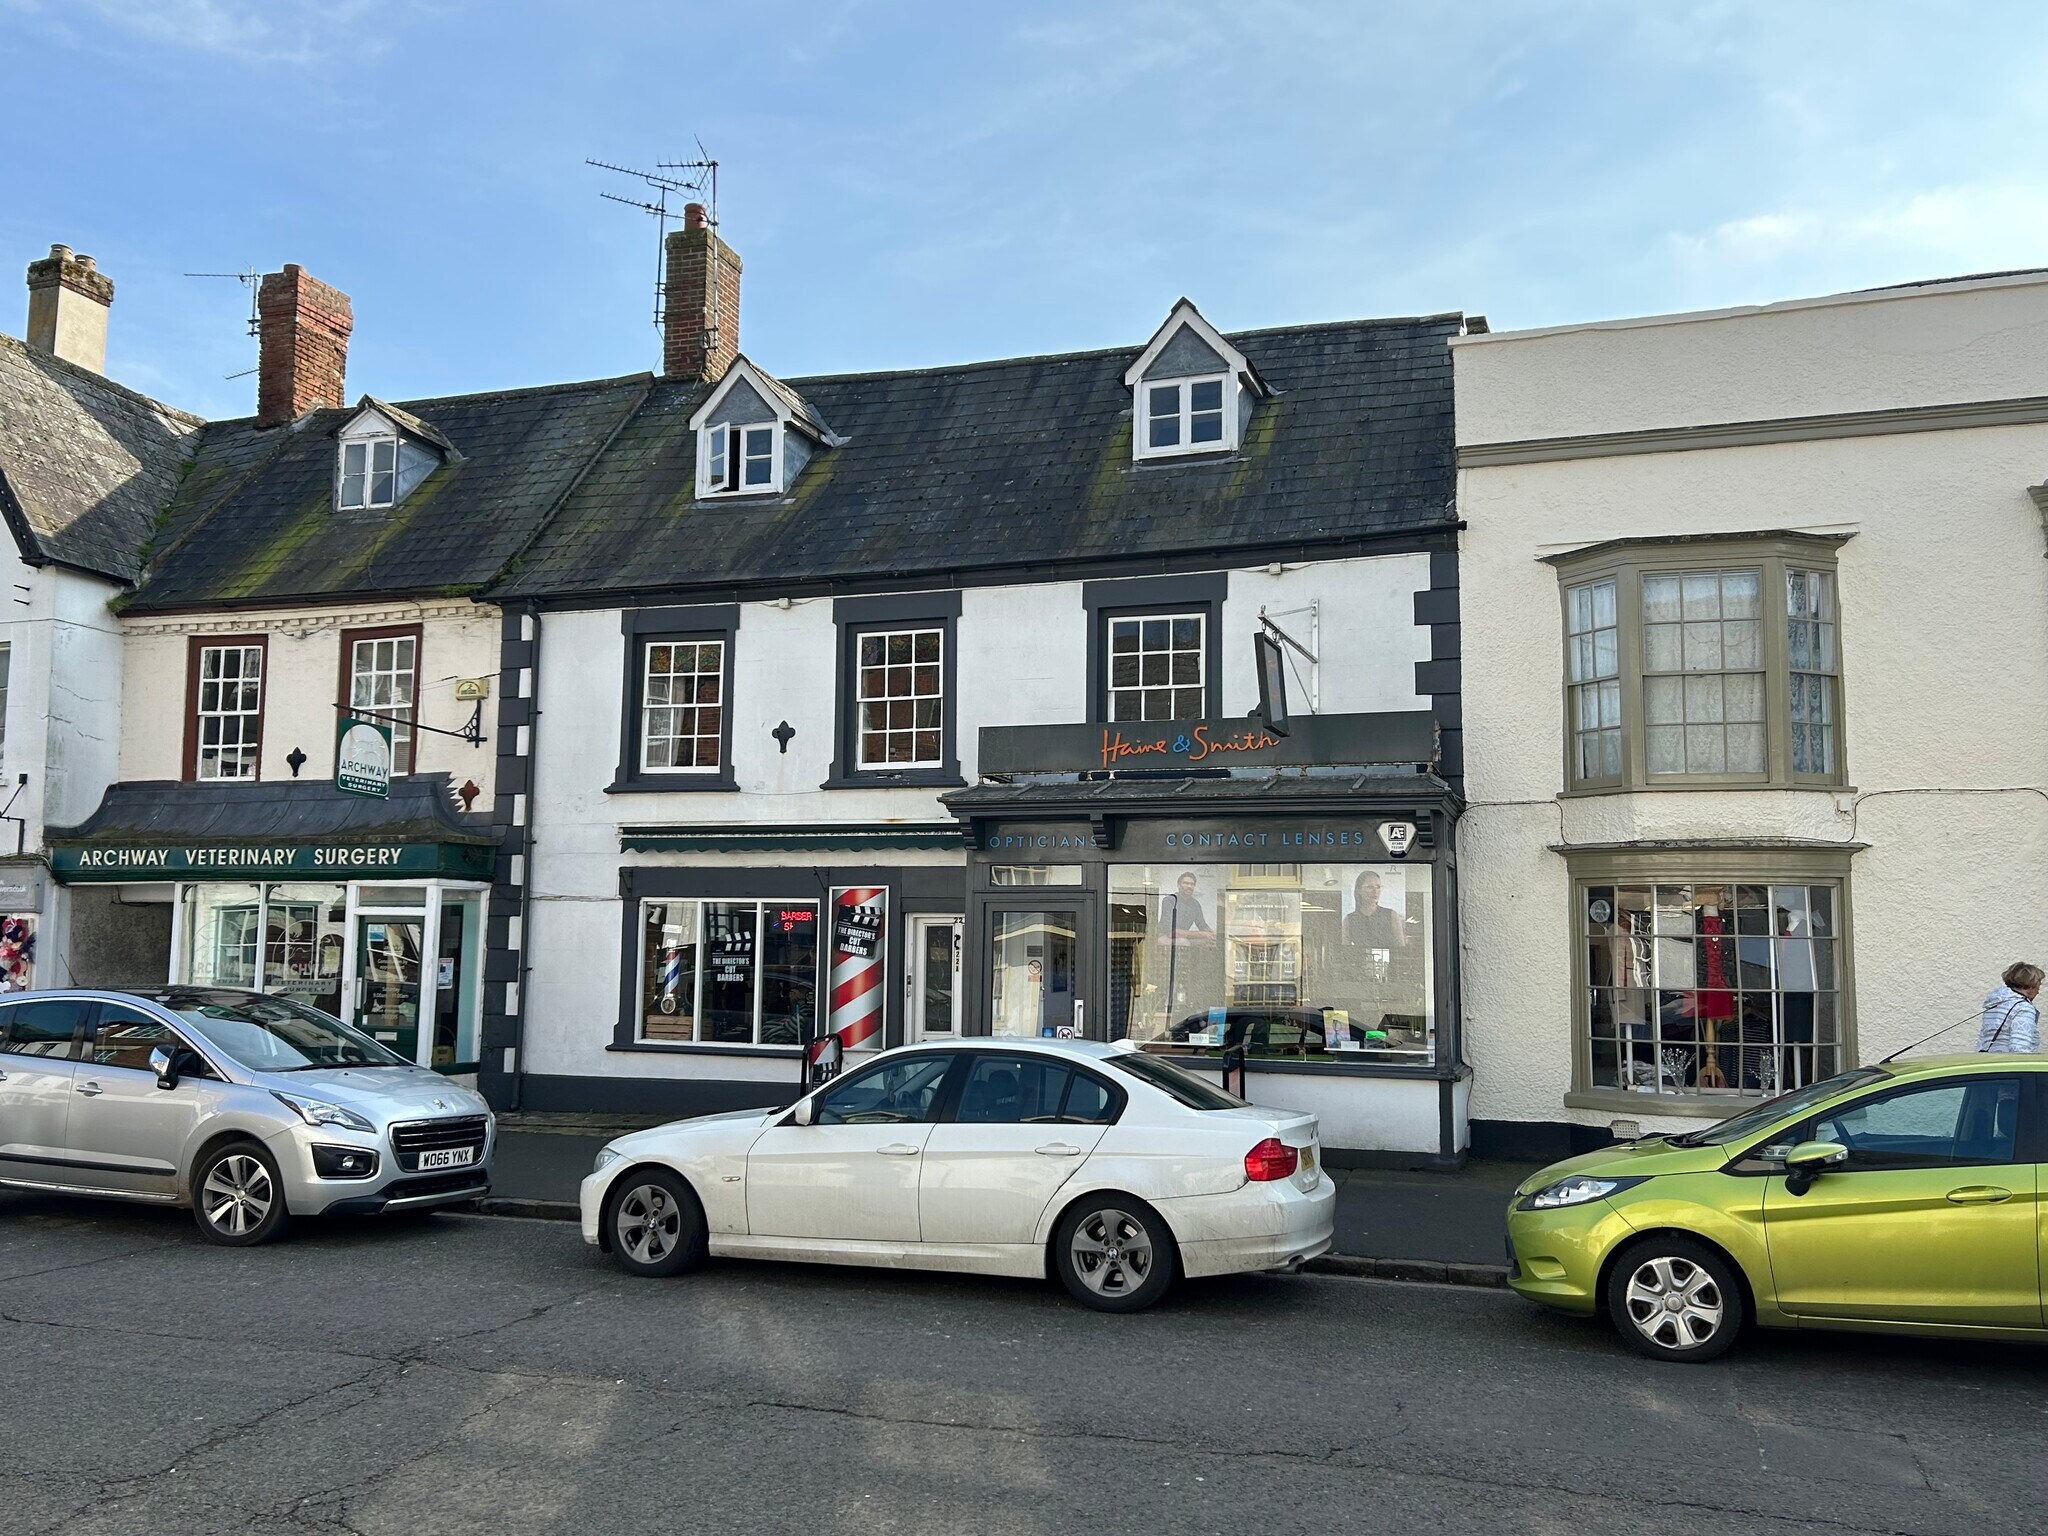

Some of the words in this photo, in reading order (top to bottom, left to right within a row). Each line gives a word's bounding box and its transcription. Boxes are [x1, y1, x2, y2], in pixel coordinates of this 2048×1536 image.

[1102, 729, 1167, 769] Haine
[1172, 734, 1190, 753] &
[1189, 726, 1280, 761] Smith
[341, 759, 389, 779] ARCHWAY
[341, 775, 386, 788] VETERINARY
[347, 782, 382, 793] SURGERY
[1166, 833, 1268, 847] CONTACT
[1282, 831, 1364, 845] LENSES
[79, 849, 169, 867] ARCHWAY
[185, 848, 297, 866] VETERINARY
[314, 847, 403, 865] SURGERY
[781, 911, 813, 921] BARBER
[837, 926, 847, 935] THE
[847, 928, 876, 940] DIRECTOR'S
[849, 936, 862, 946] CUT
[839, 942, 868, 956] BARBERS
[712, 957, 721, 965] THE
[722, 957, 750, 965] DIRECTOR'S
[725, 965, 737, 974] CUT
[717, 973, 744, 982] BARBERS
[423, 1152, 450, 1167] WO66
[452, 1149, 470, 1164] YNX
